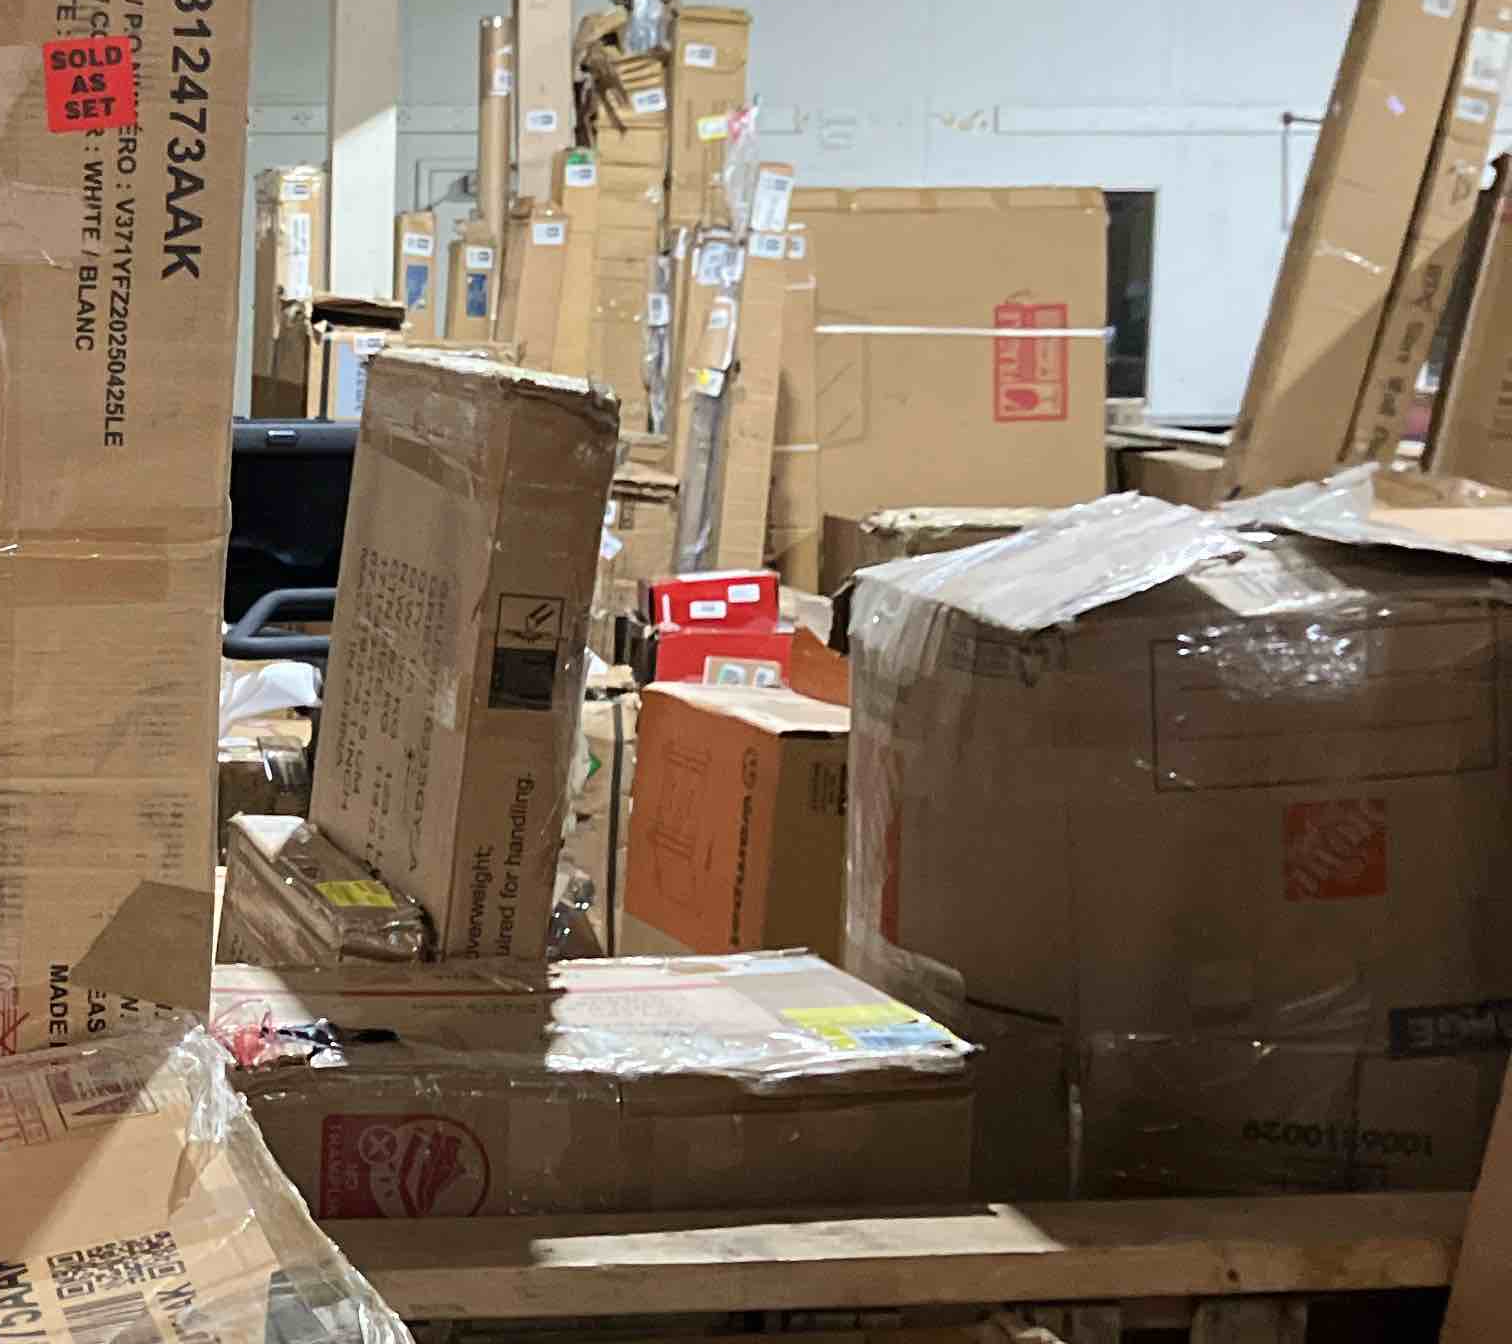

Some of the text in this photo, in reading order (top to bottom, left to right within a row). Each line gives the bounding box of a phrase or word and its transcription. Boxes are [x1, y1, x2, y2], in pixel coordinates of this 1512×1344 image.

[51, 46, 123, 71] SOLD
[64, 97, 116, 119] SET
[70, 73, 106, 94] AS
[81, 160, 103, 241] WHITE
[74, 265, 97, 352] BLANC
[104, 197, 135, 448] V371YFZ20250425LE
[499, 871, 519, 899] for
[48, 964, 68, 1035] MADE
